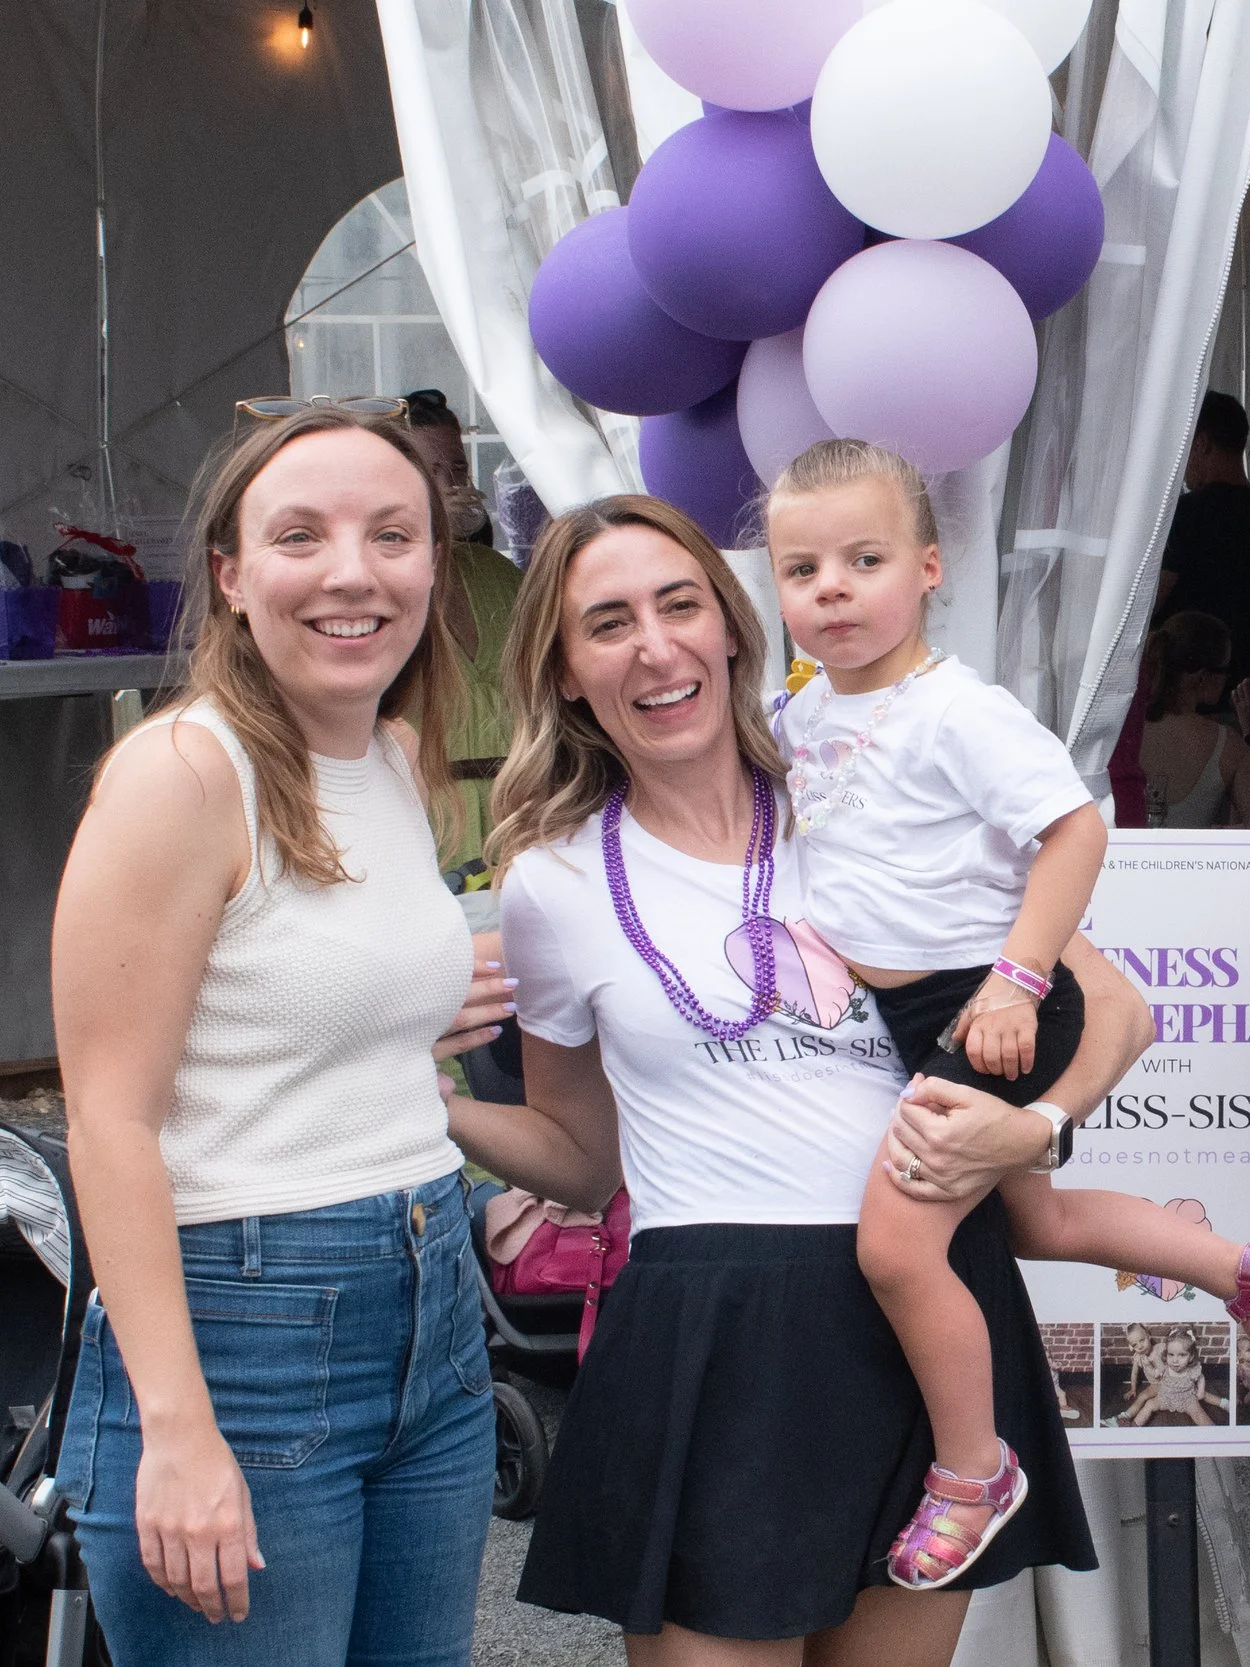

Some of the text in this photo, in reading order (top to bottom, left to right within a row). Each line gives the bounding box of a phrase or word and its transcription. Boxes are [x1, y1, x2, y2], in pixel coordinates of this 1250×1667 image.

[1108, 860, 1116, 870] &
[1118, 860, 1139, 870] THE
[1141, 860, 1204, 870] CHILDREN'S
[1097, 947, 1240, 988] NESS
[694, 1035, 901, 1064] THE LISS-SIS
[1141, 1059, 1192, 1074] WITH
